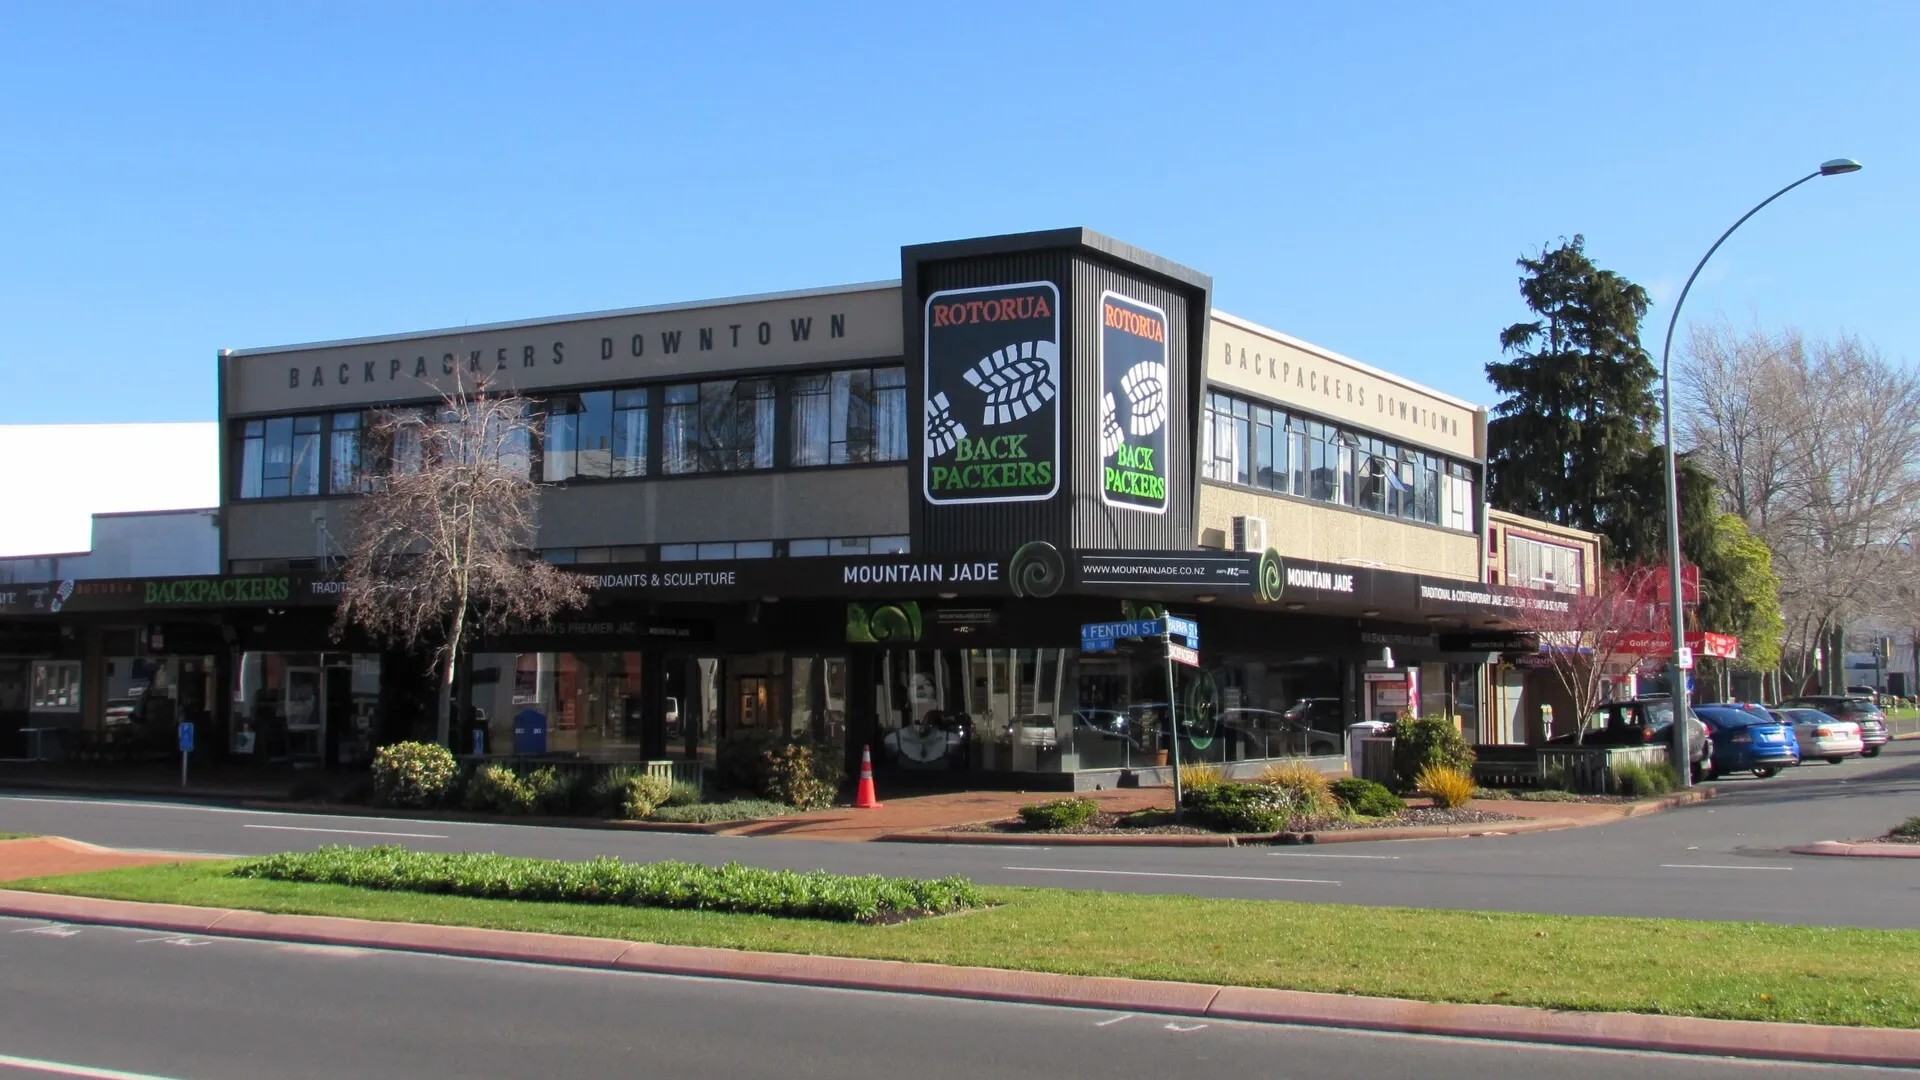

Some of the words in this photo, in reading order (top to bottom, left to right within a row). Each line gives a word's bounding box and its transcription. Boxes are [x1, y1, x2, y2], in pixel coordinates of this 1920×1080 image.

[933, 296, 1050, 326] ROTORUA
[1104, 304, 1162, 342] ROTORUA
[289, 341, 564, 388] BACKPACKERS
[601, 313, 845, 360] DOWNTOWN
[1224, 342, 1363, 406] BACKPACKERS
[1377, 393, 1456, 436] DOWNTOWN
[955, 434, 1027, 461] BACK
[1117, 443, 1153, 471] BACK
[932, 462, 1051, 489] PACKERS
[1105, 467, 1164, 499] PACKERS
[651, 574, 660, 586] &
[663, 572, 736, 586] SCULPTURE
[844, 564, 942, 583] MOUNTAIN
[949, 562, 998, 581] JADE
[1082, 565, 1205, 576] WWW.MOUNTAINJADE.CO.NZ
[1287, 568, 1331, 590] MOUNTAIN
[1333, 574, 1353, 592] JADE
[144, 577, 289, 605] BACKPACKERS
[1091, 625, 1137, 638] FENTON
[1142, 622, 1157, 635] ST
